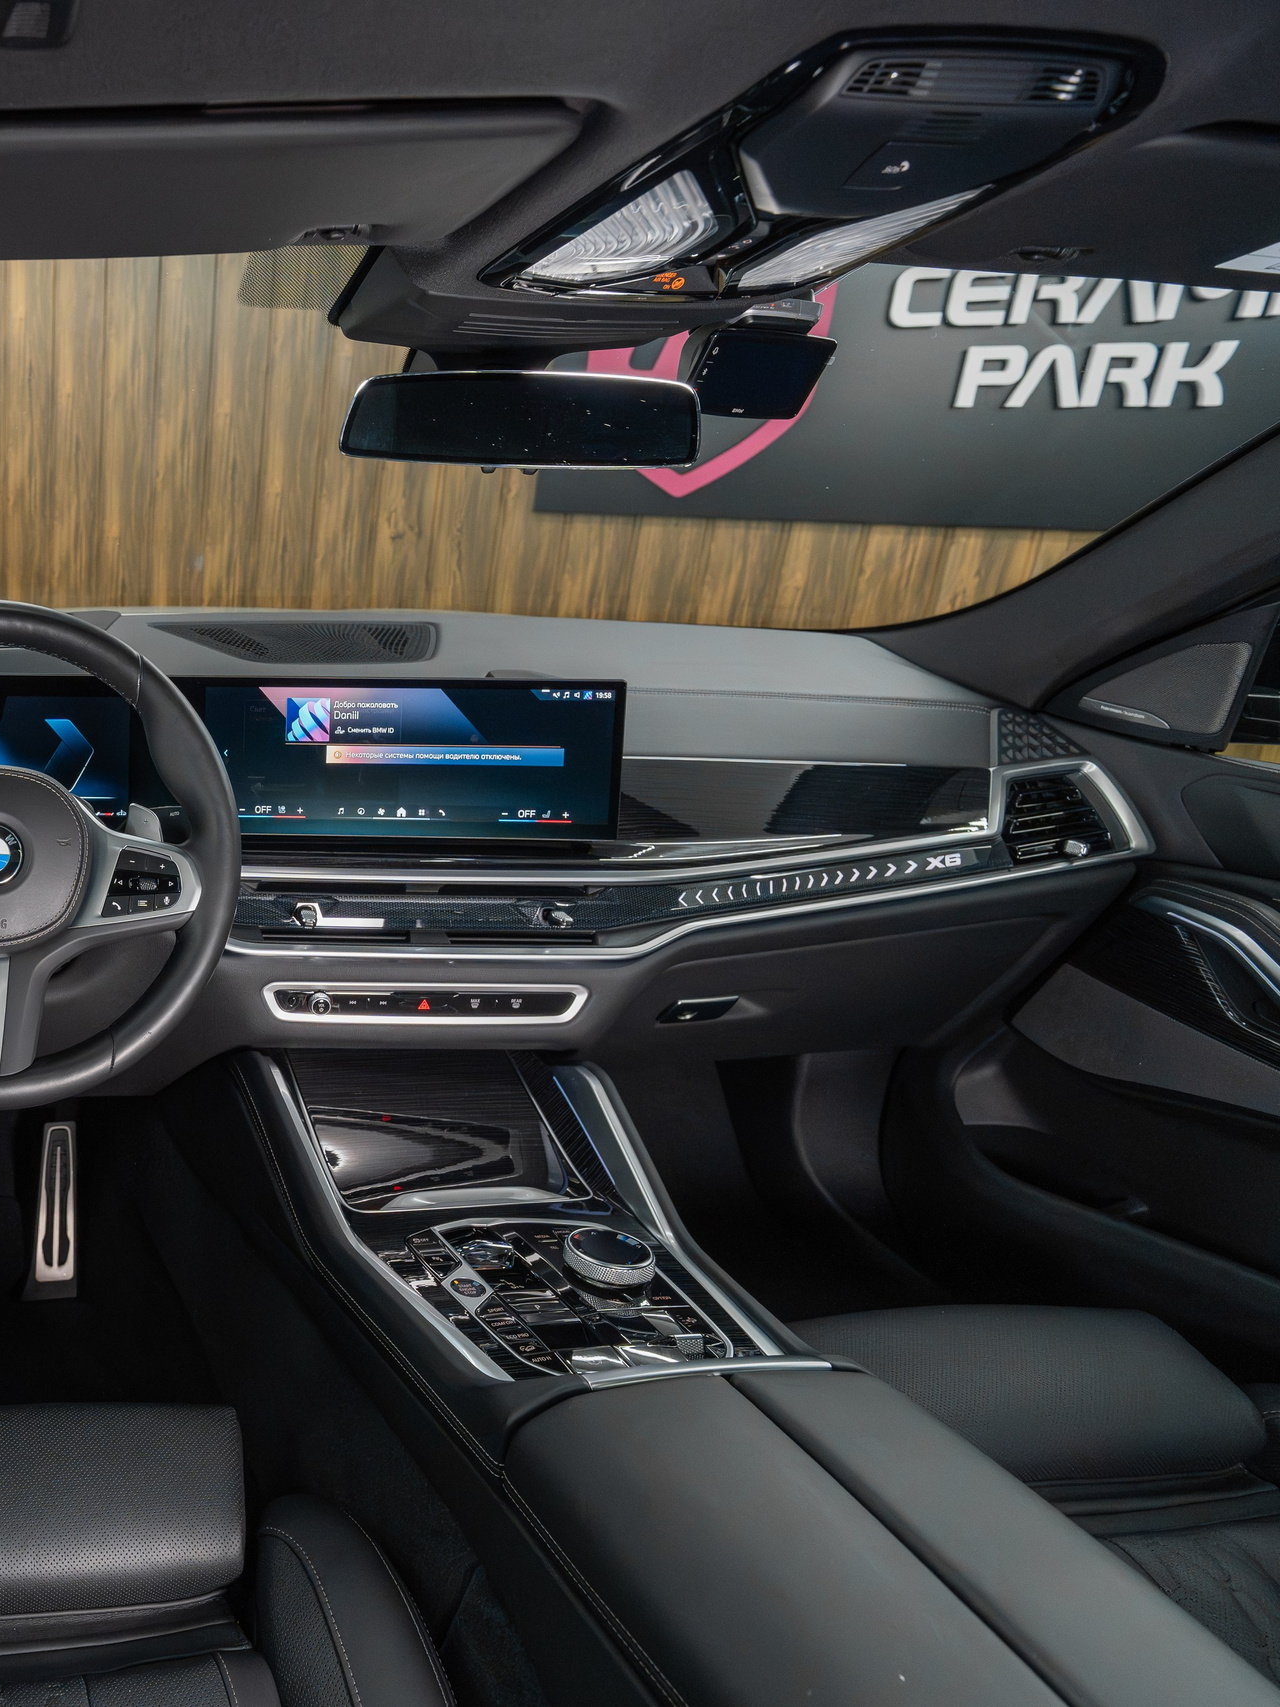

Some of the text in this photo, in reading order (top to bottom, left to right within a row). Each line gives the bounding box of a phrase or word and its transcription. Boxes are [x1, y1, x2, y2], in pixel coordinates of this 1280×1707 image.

[888, 267, 1280, 328] CERAM
[953, 340, 1240, 409] PARK
[334, 701, 356, 709] Добро
[334, 711, 359, 720] Daniil
[345, 751, 383, 760] Некоторые
[415, 753, 444, 761] помощи
[445, 753, 479, 761] водителю
[254, 805, 272, 814] OFF
[517, 809, 536, 818] OFF
[925, 853, 962, 870] X6
